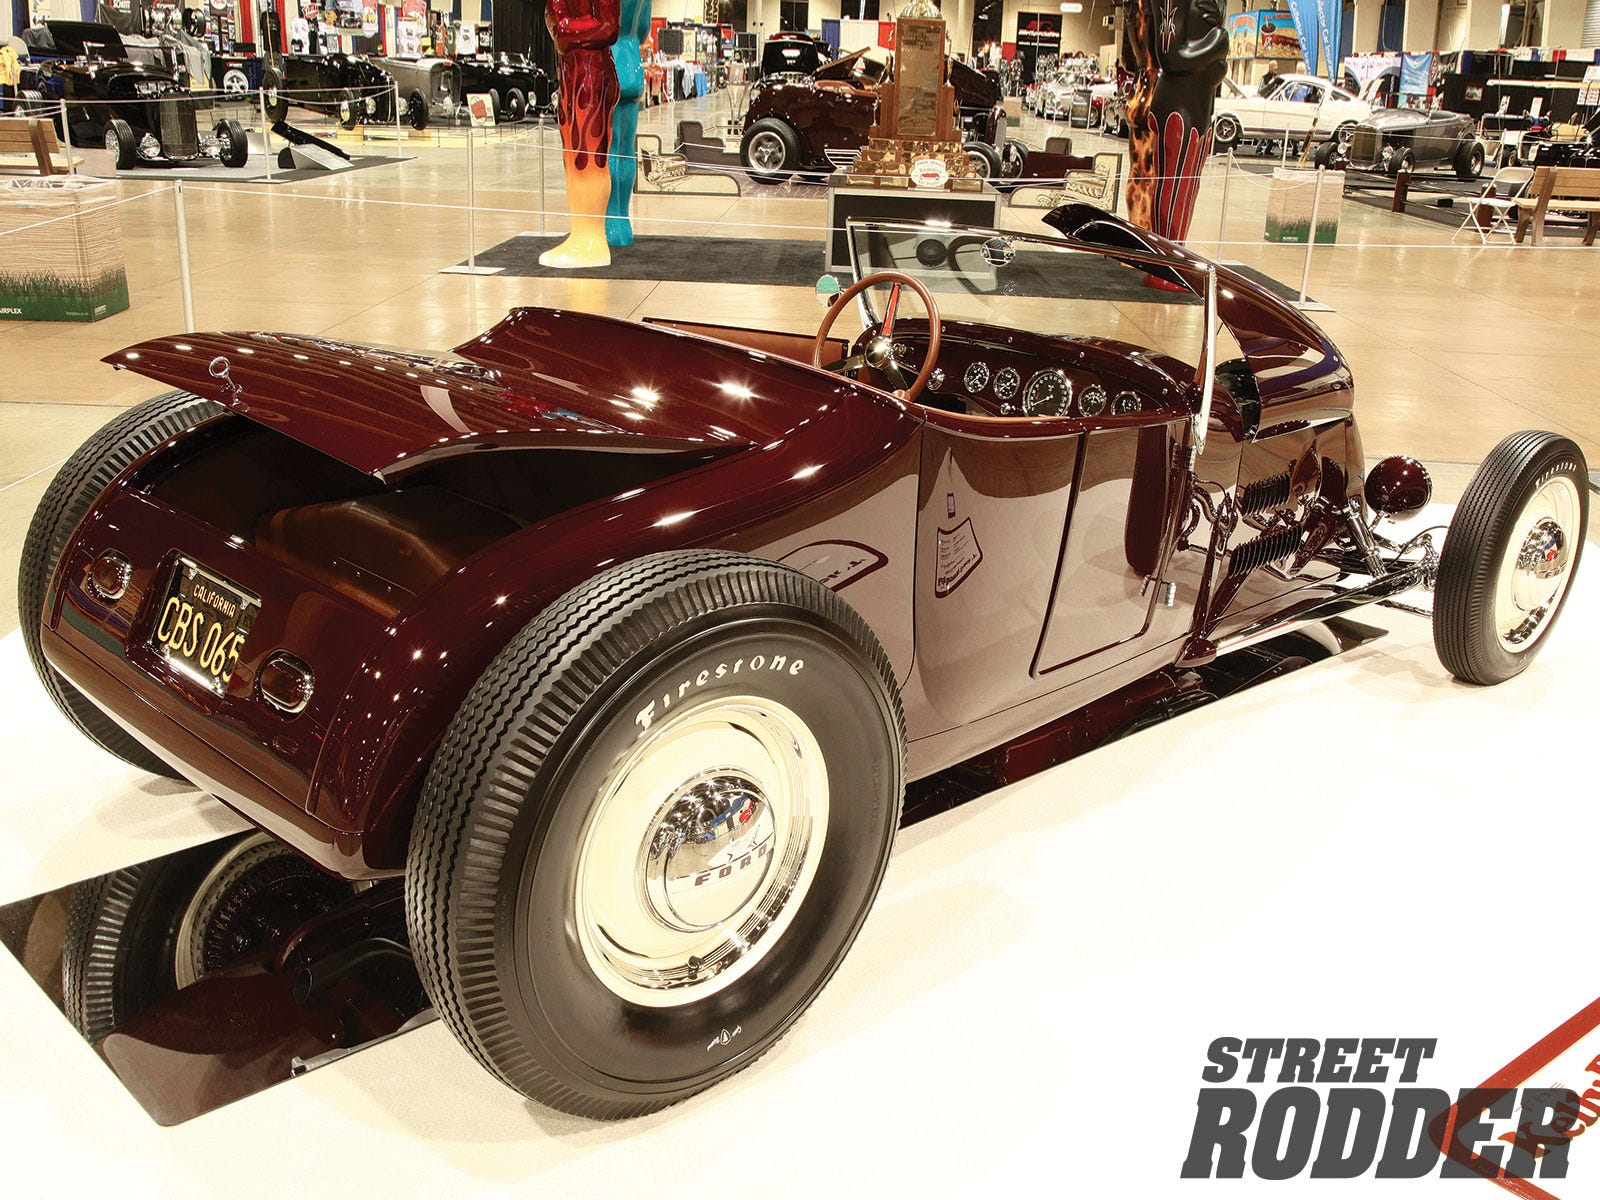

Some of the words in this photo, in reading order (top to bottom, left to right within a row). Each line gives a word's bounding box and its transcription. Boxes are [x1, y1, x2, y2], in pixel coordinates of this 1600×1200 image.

[193, 584, 237, 618] CALIFORNIA
[157, 596, 204, 657] CBS
[199, 622, 246, 683] 065
[635, 655, 804, 739] Firestone
[694, 843, 767, 886] FORD
